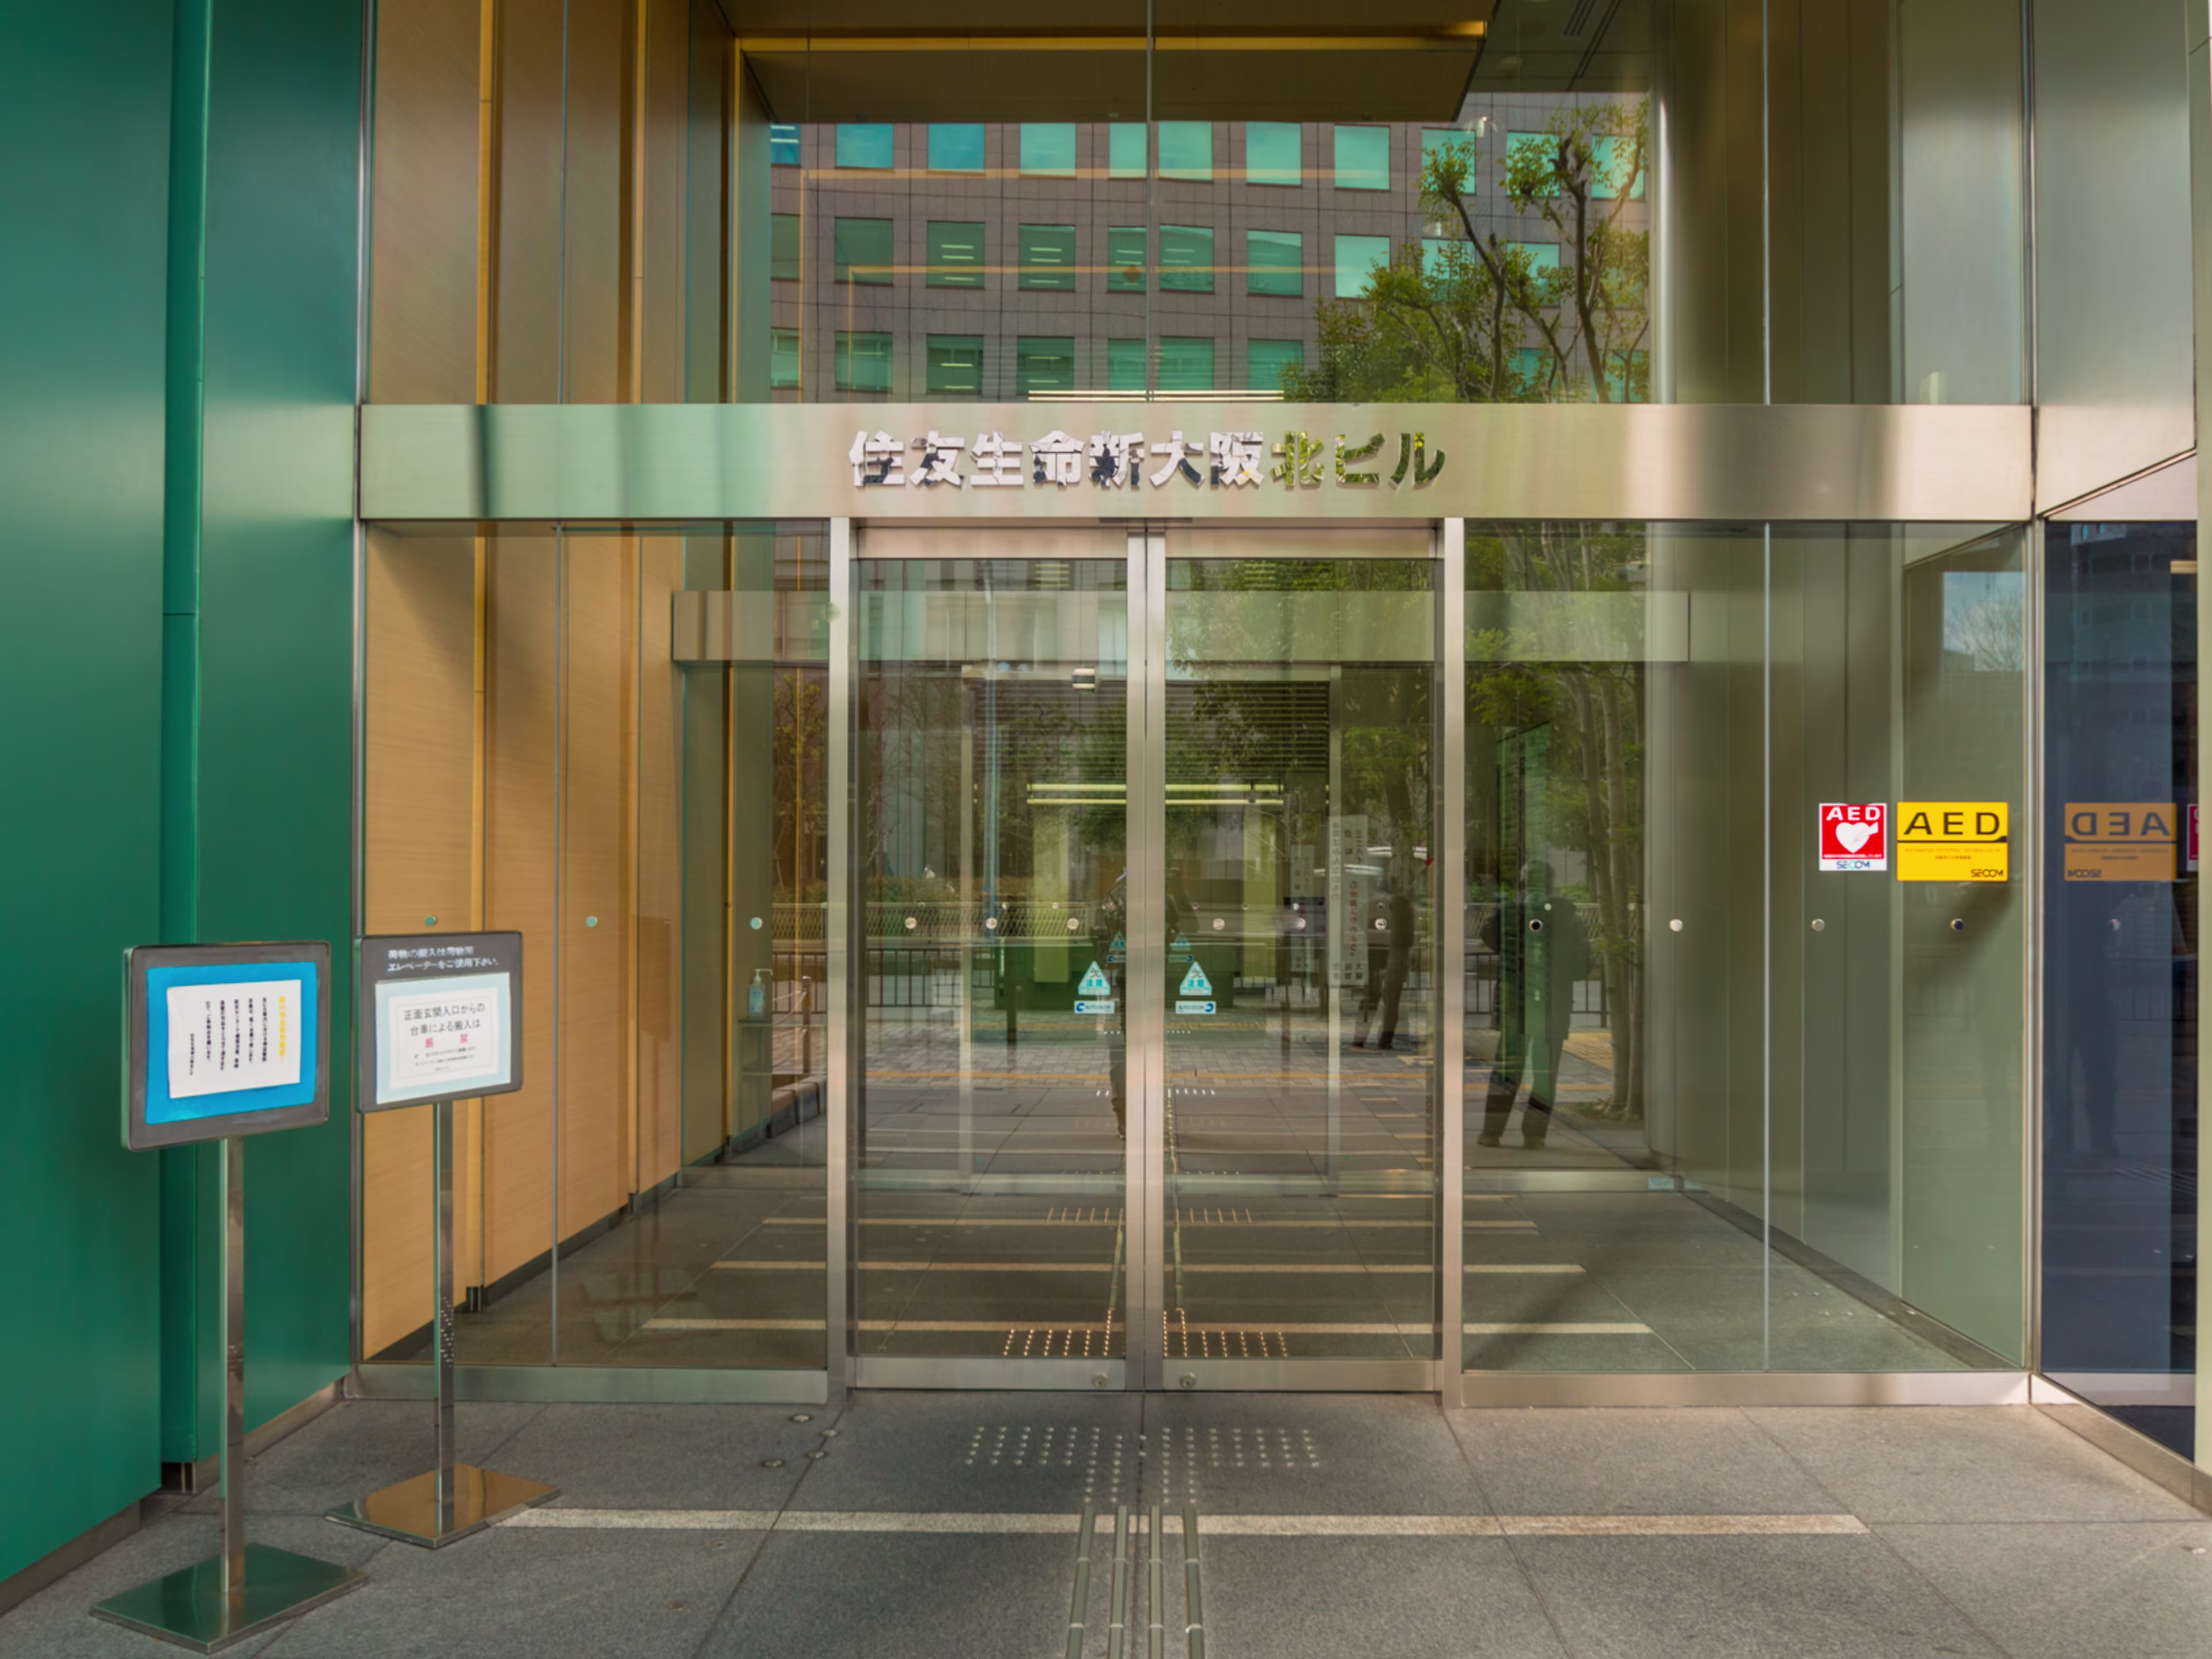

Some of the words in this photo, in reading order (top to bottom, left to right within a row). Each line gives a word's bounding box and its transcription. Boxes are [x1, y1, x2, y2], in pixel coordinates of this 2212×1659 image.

[849, 430, 1445, 488] 住友生命新大阪北ビル
[1826, 806, 1881, 821] AED
[1903, 812, 2000, 835] AED
[1836, 860, 1870, 869] SECOM
[1971, 869, 2004, 878] SECOM
[403, 1002, 486, 1021] 正面玄関入口からの
[410, 1018, 482, 1036] 台車による搬入は
